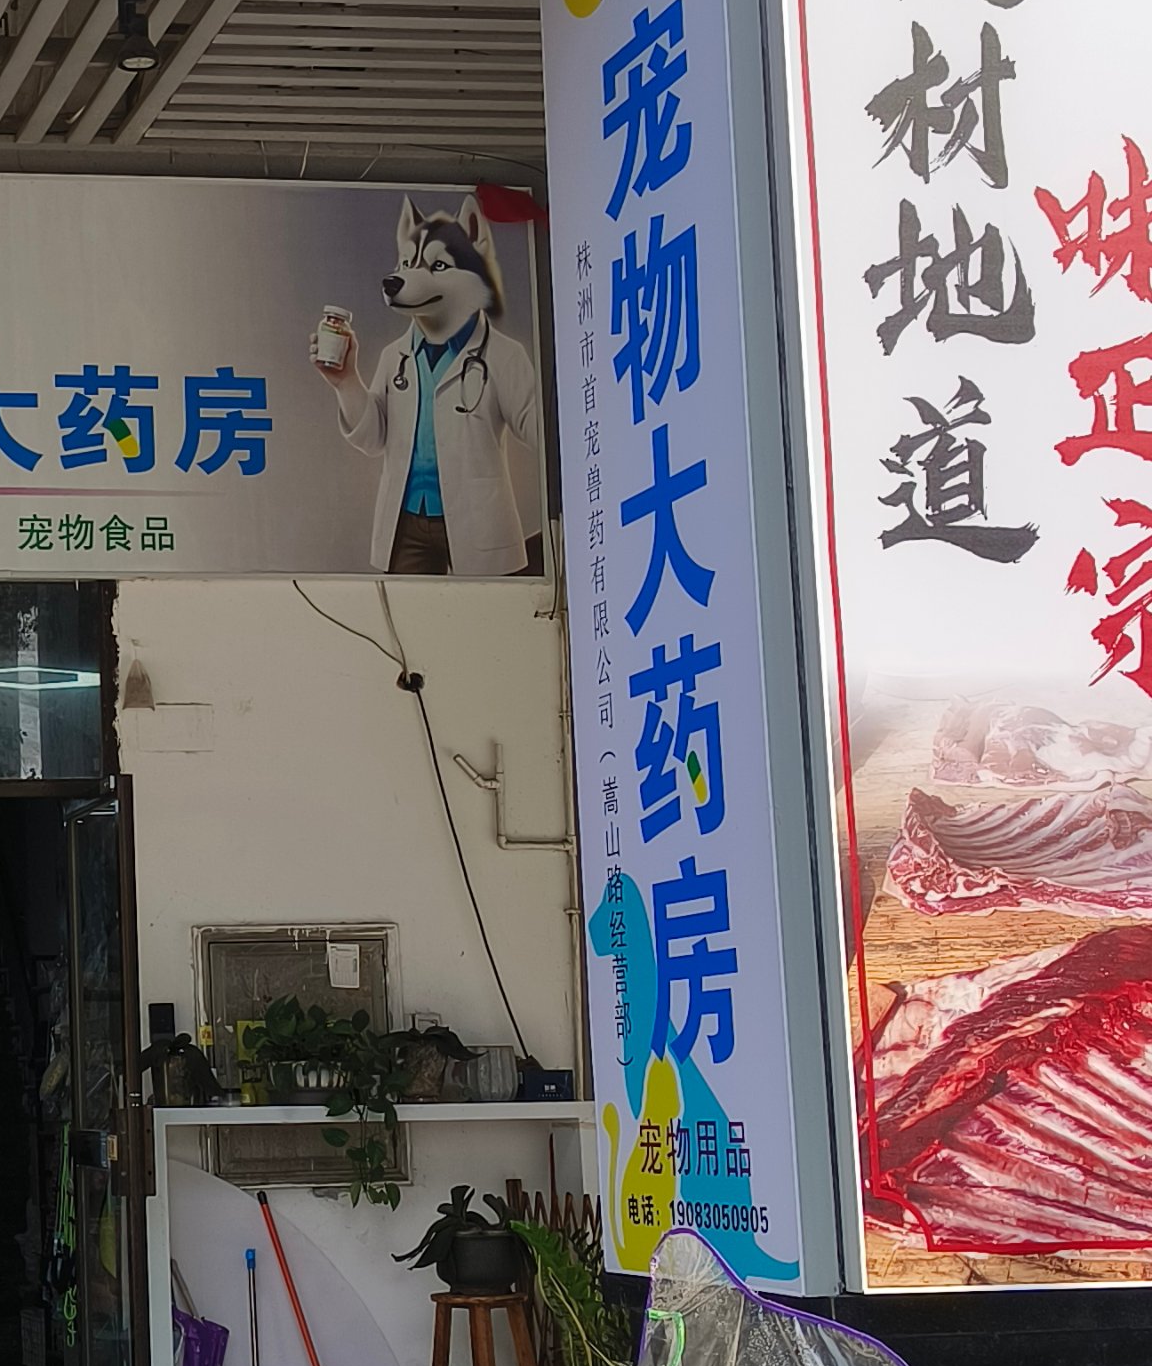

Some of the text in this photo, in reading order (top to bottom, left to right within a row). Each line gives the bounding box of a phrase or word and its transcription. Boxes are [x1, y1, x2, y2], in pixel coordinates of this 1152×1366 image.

[17, 513, 176, 552] 宠物食品
[639, 1121, 751, 1178] 宠物用品
